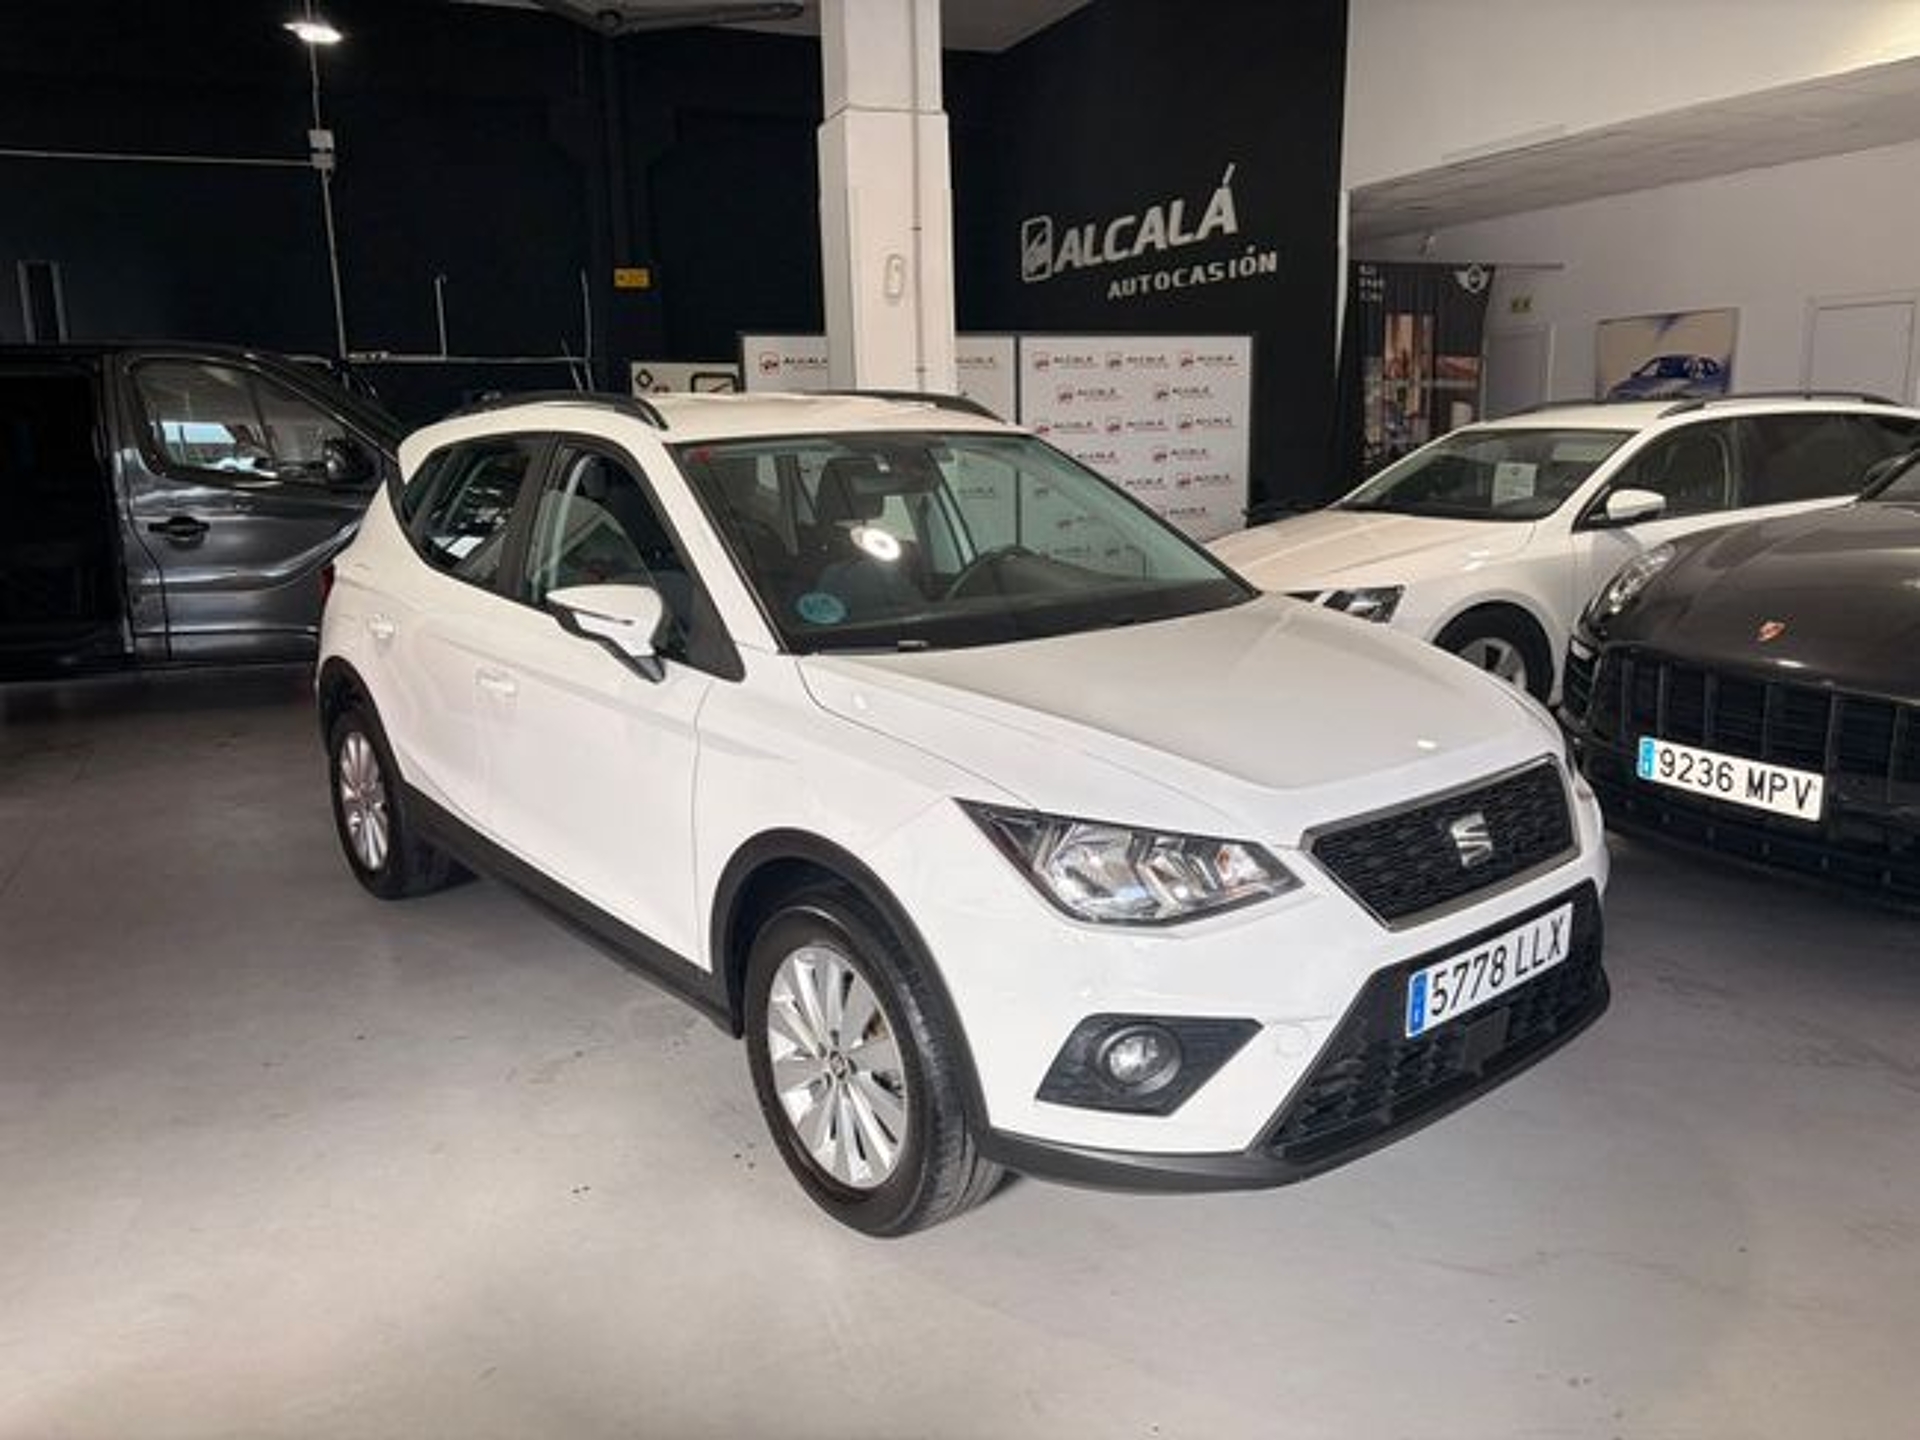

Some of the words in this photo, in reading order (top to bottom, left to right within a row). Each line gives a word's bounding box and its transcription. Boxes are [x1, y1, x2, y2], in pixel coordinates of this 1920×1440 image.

[1054, 162, 1238, 272] ALCALÁ
[1107, 245, 1277, 299] AUTOCASIÓN
[1659, 748, 1734, 793] 9236
[1745, 766, 1813, 810] MPV
[1431, 944, 1507, 1016] 5778
[1515, 914, 1566, 977] LLX
